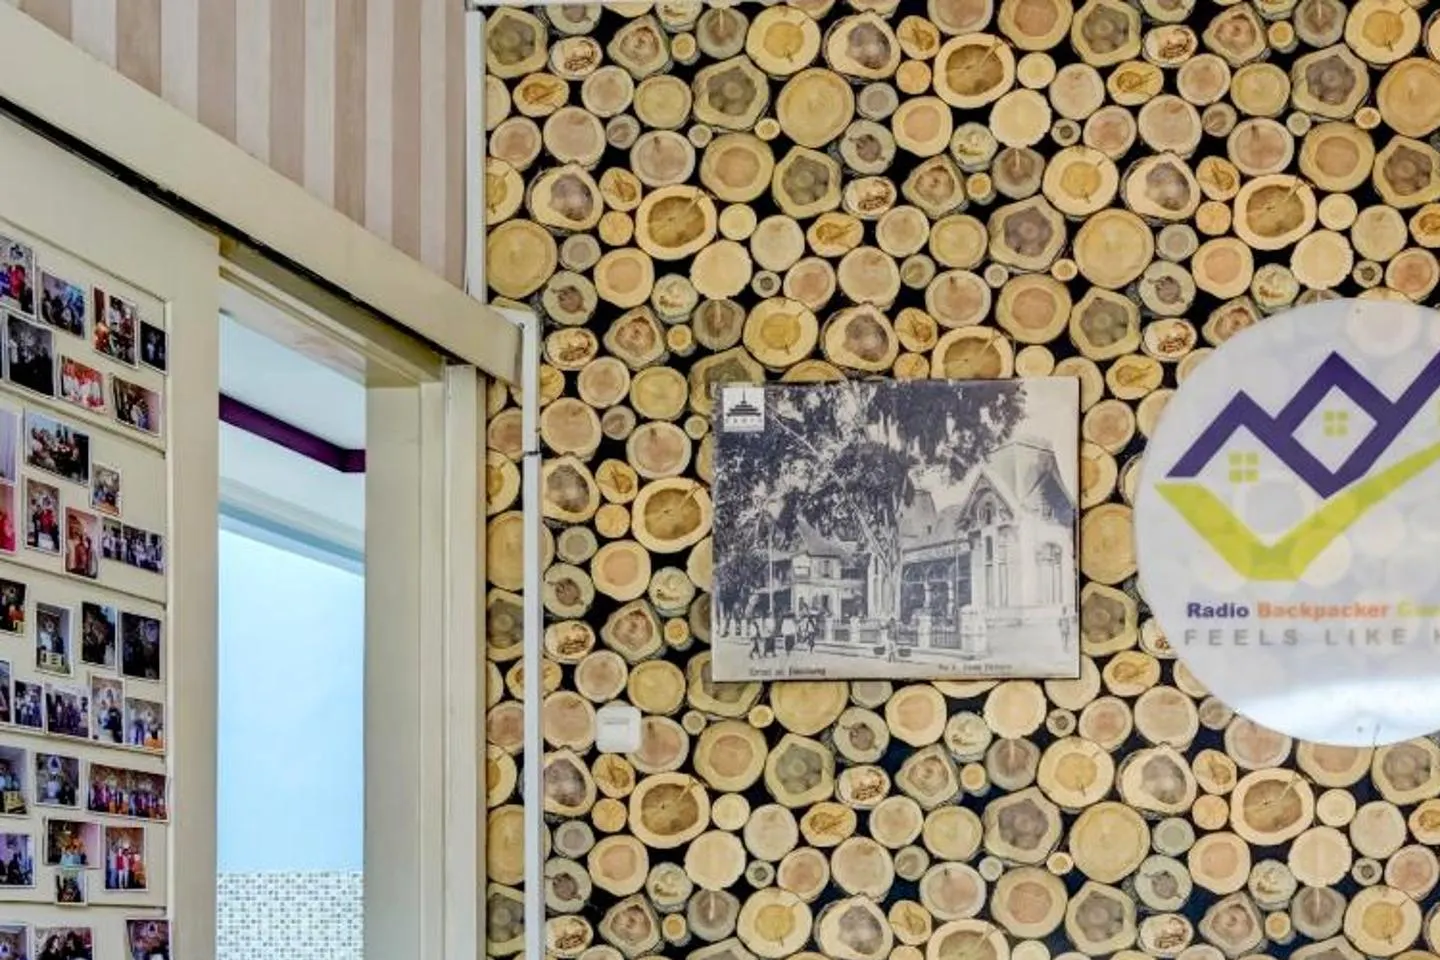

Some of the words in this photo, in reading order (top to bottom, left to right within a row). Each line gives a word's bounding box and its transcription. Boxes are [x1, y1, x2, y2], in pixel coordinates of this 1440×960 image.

[1186, 601, 1250, 618] Radio
[1257, 601, 1390, 623] Backpacker
[1184, 628, 1299, 647] FEELS
[1325, 627, 1408, 646] LIKE
